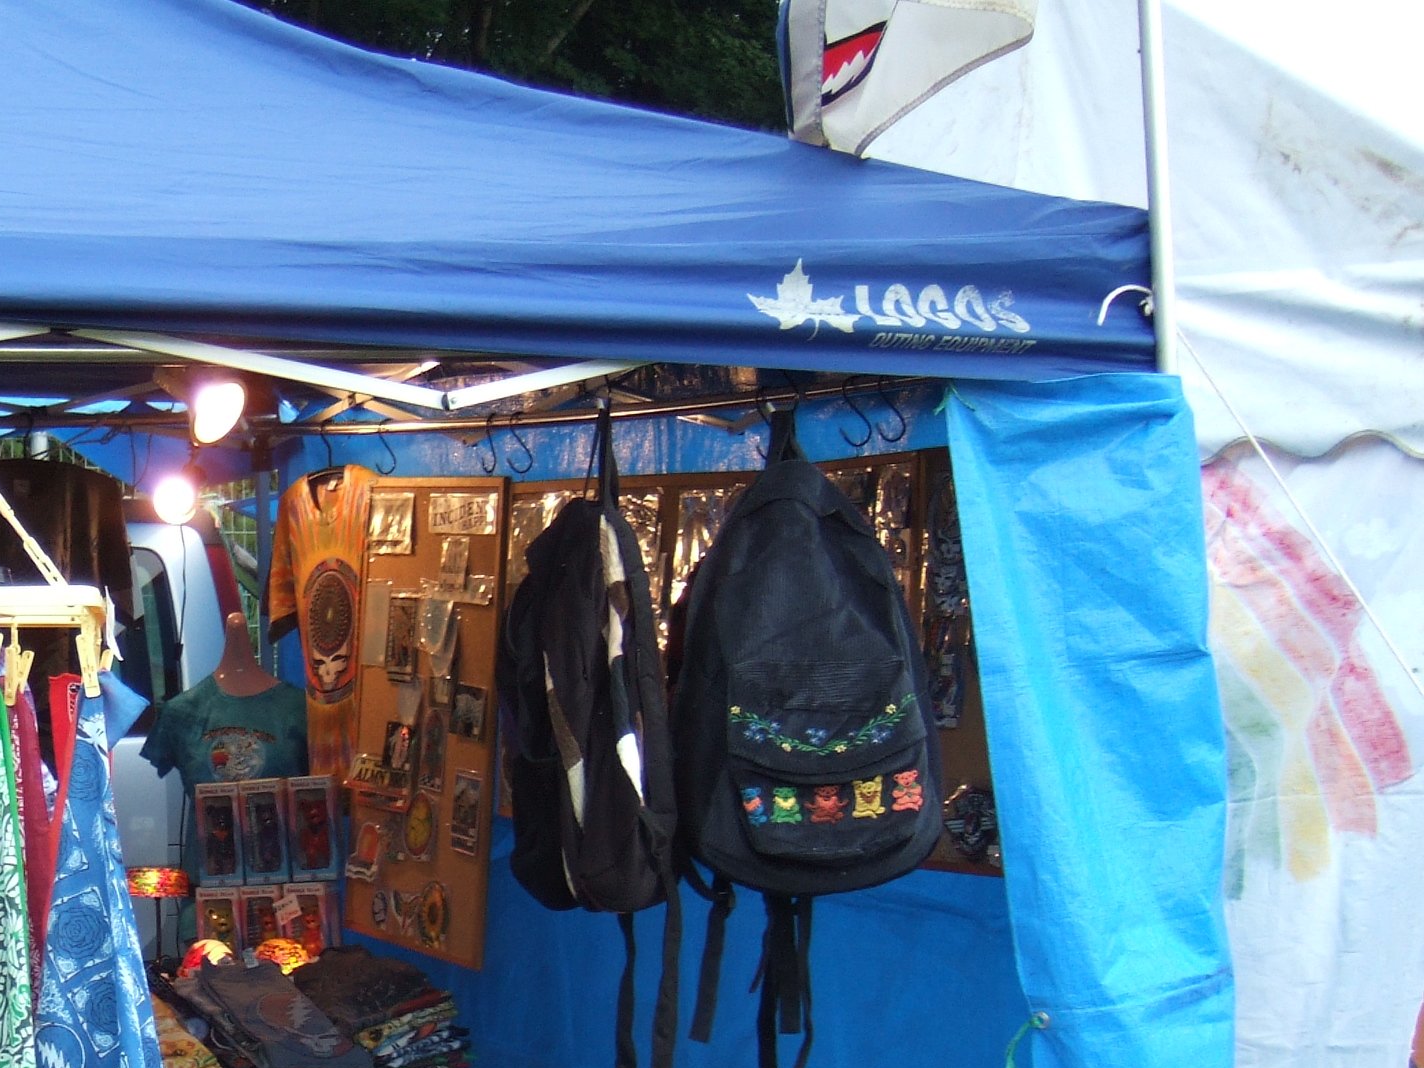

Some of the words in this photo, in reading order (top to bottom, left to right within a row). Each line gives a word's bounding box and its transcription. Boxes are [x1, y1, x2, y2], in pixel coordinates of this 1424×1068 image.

[854, 283, 1031, 333] LOGOS
[869, 332, 937, 351] OUTING
[934, 335, 1036, 355] EQUIPMENT
